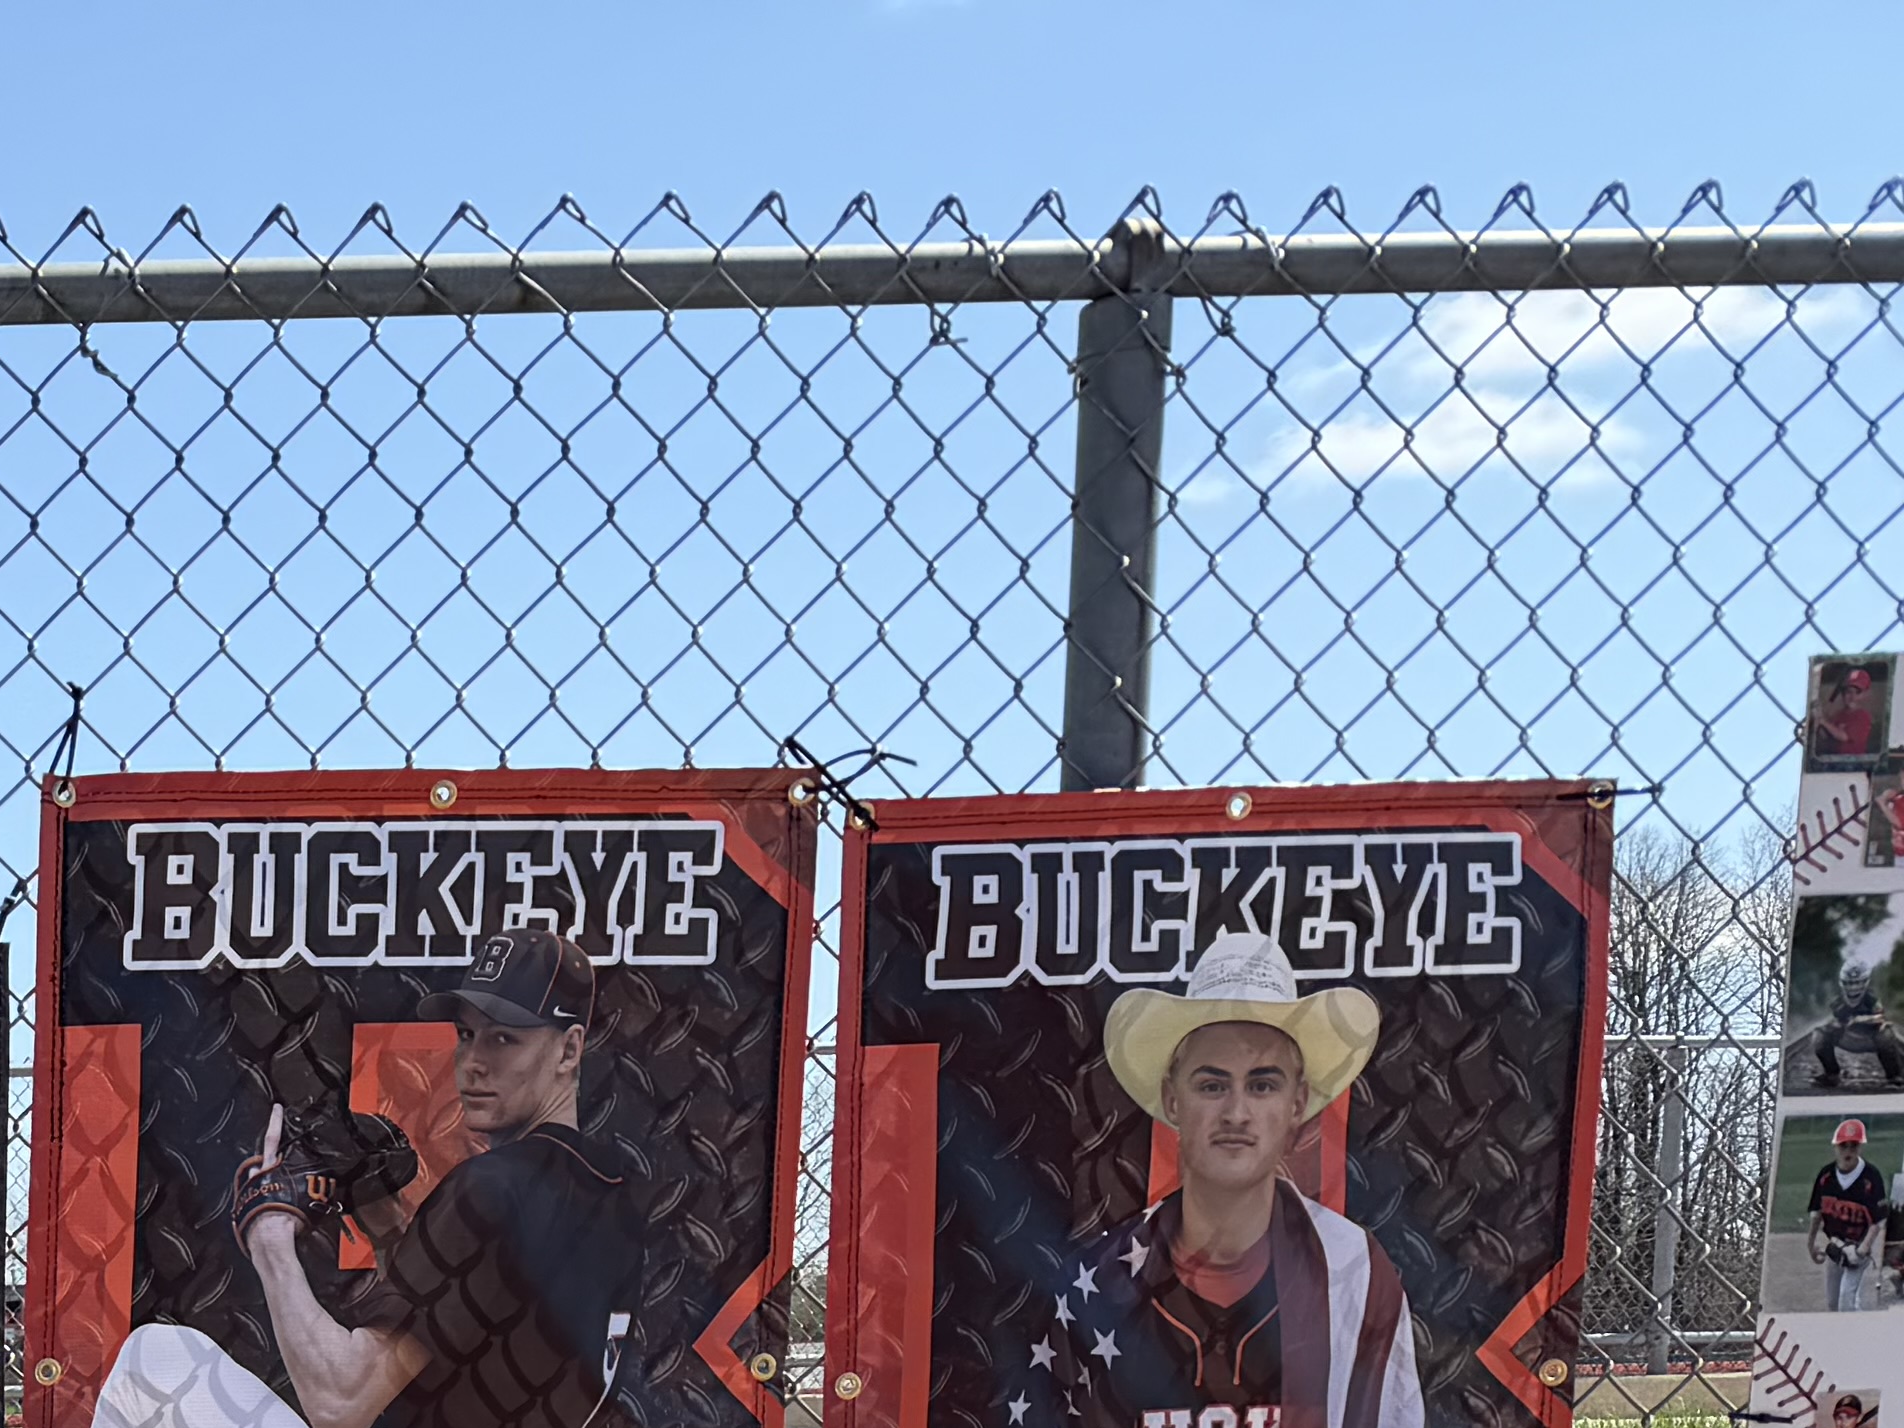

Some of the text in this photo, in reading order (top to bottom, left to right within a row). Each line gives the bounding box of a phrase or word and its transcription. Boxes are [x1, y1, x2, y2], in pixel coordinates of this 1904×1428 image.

[123, 820, 725, 971] BUCKEYE
[471, 936, 514, 982] B
[925, 832, 1523, 991] BUCKEYE
